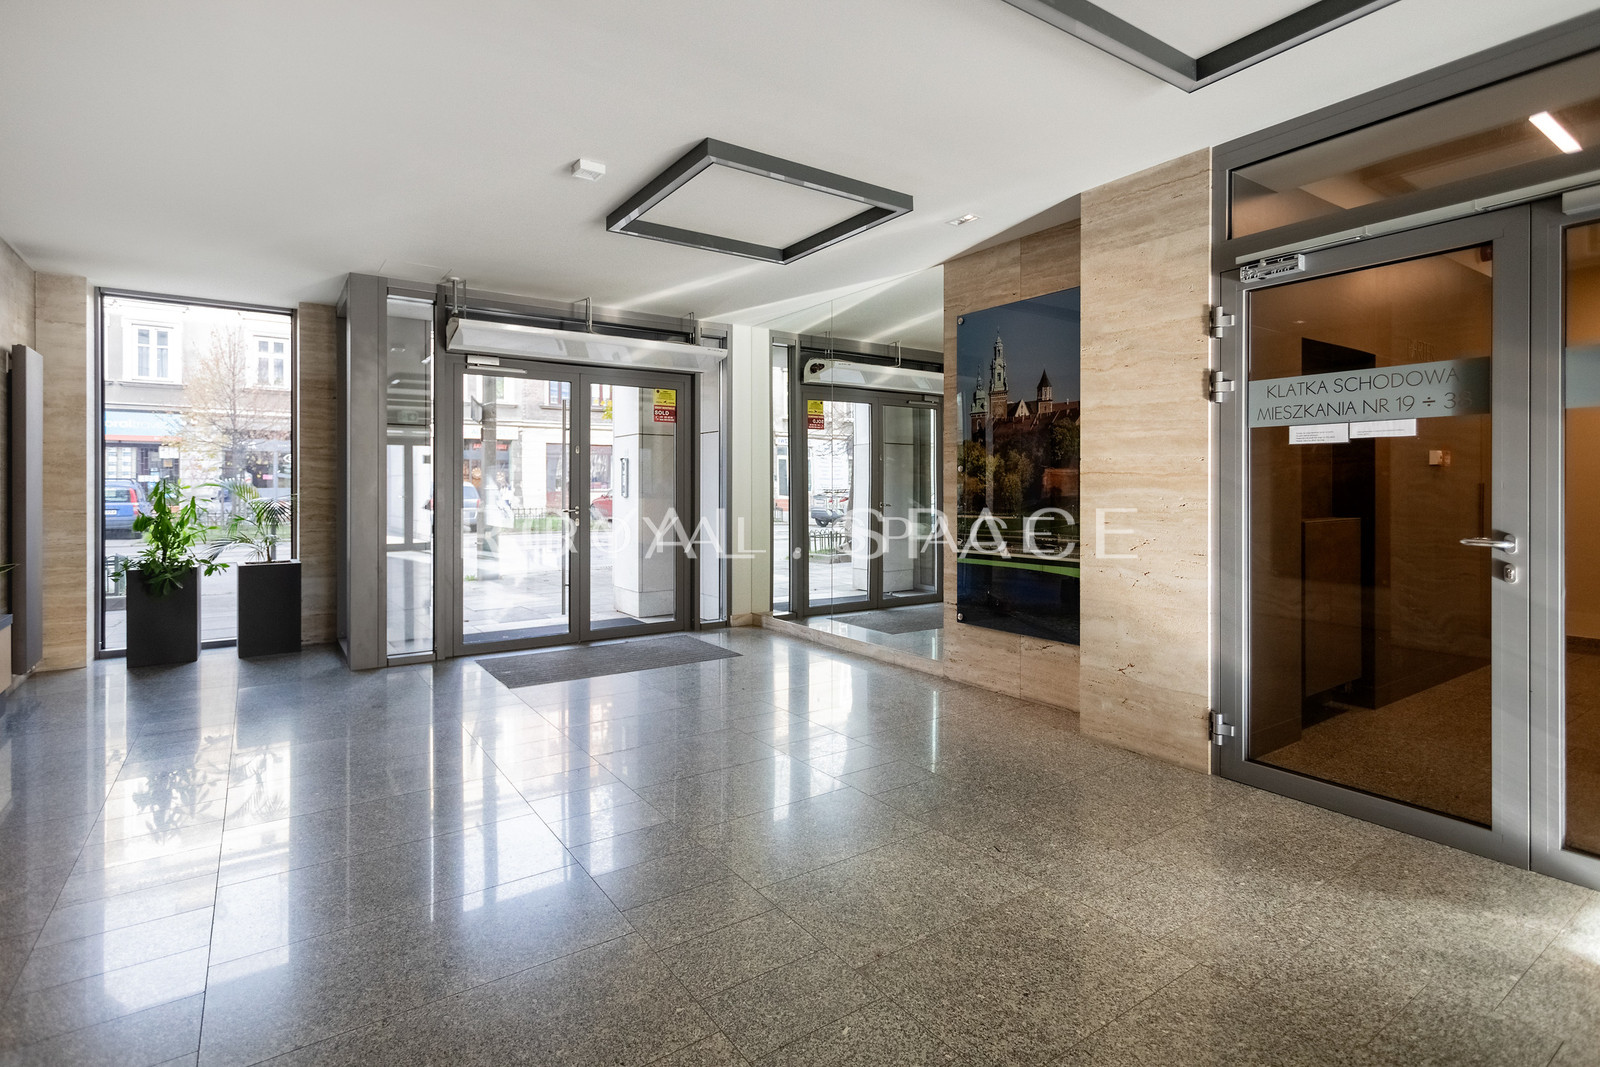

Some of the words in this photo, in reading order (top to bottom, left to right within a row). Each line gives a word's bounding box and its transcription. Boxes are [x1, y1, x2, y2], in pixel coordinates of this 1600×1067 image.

[1266, 380, 1329, 399] KLATKA
[1333, 367, 1460, 394] SCHODOWA
[1257, 400, 1357, 421] MIESZKANIA
[1362, 398, 1390, 415] NR
[1395, 395, 1415, 412] 19
